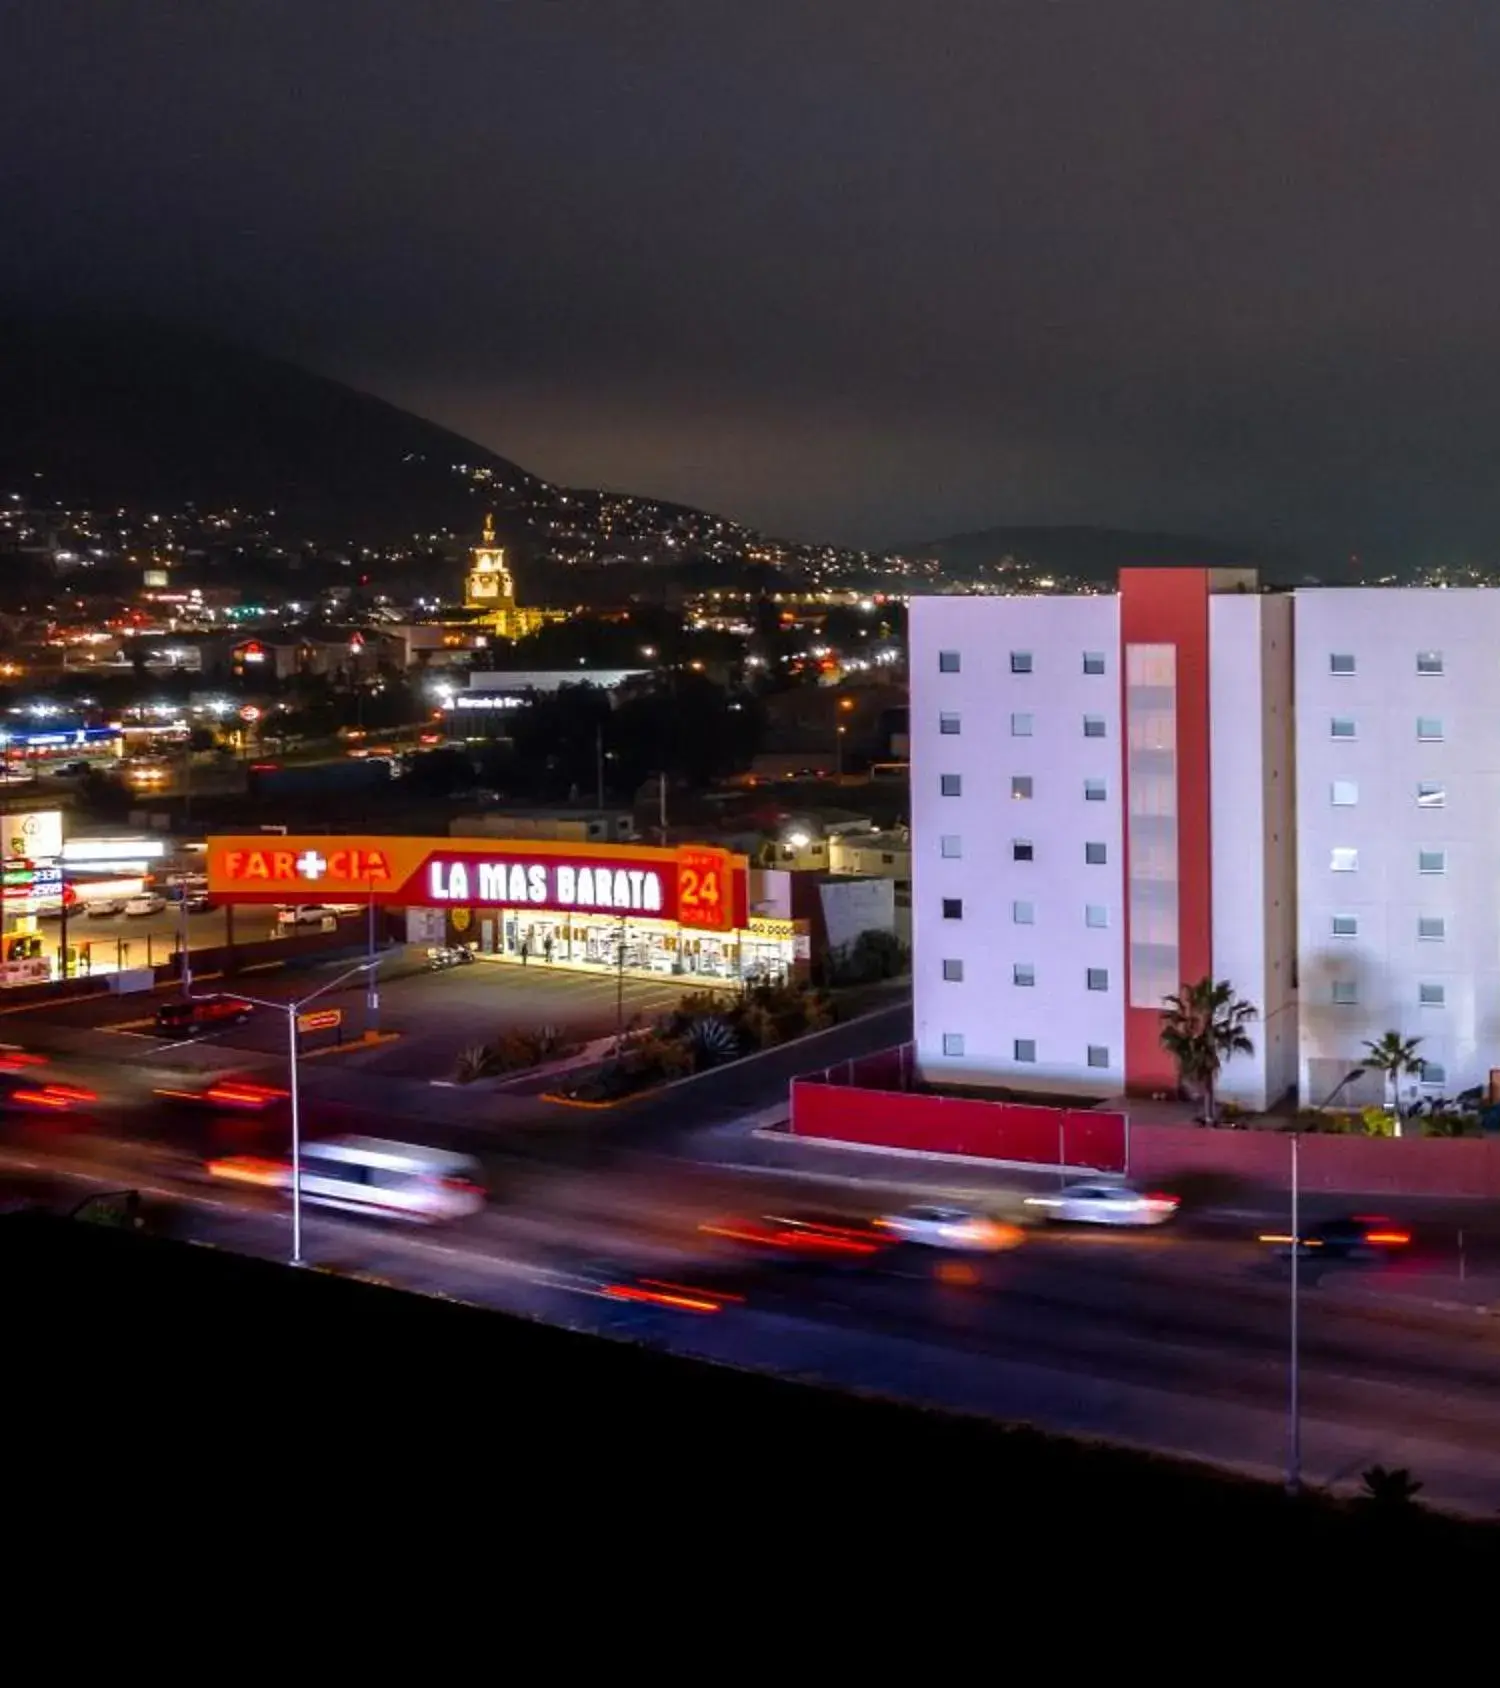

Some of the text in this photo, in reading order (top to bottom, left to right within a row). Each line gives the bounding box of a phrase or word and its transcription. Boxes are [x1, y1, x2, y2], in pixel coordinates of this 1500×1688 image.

[431, 861, 661, 911] LA MAS BARATA
[680, 868, 718, 906] 24
